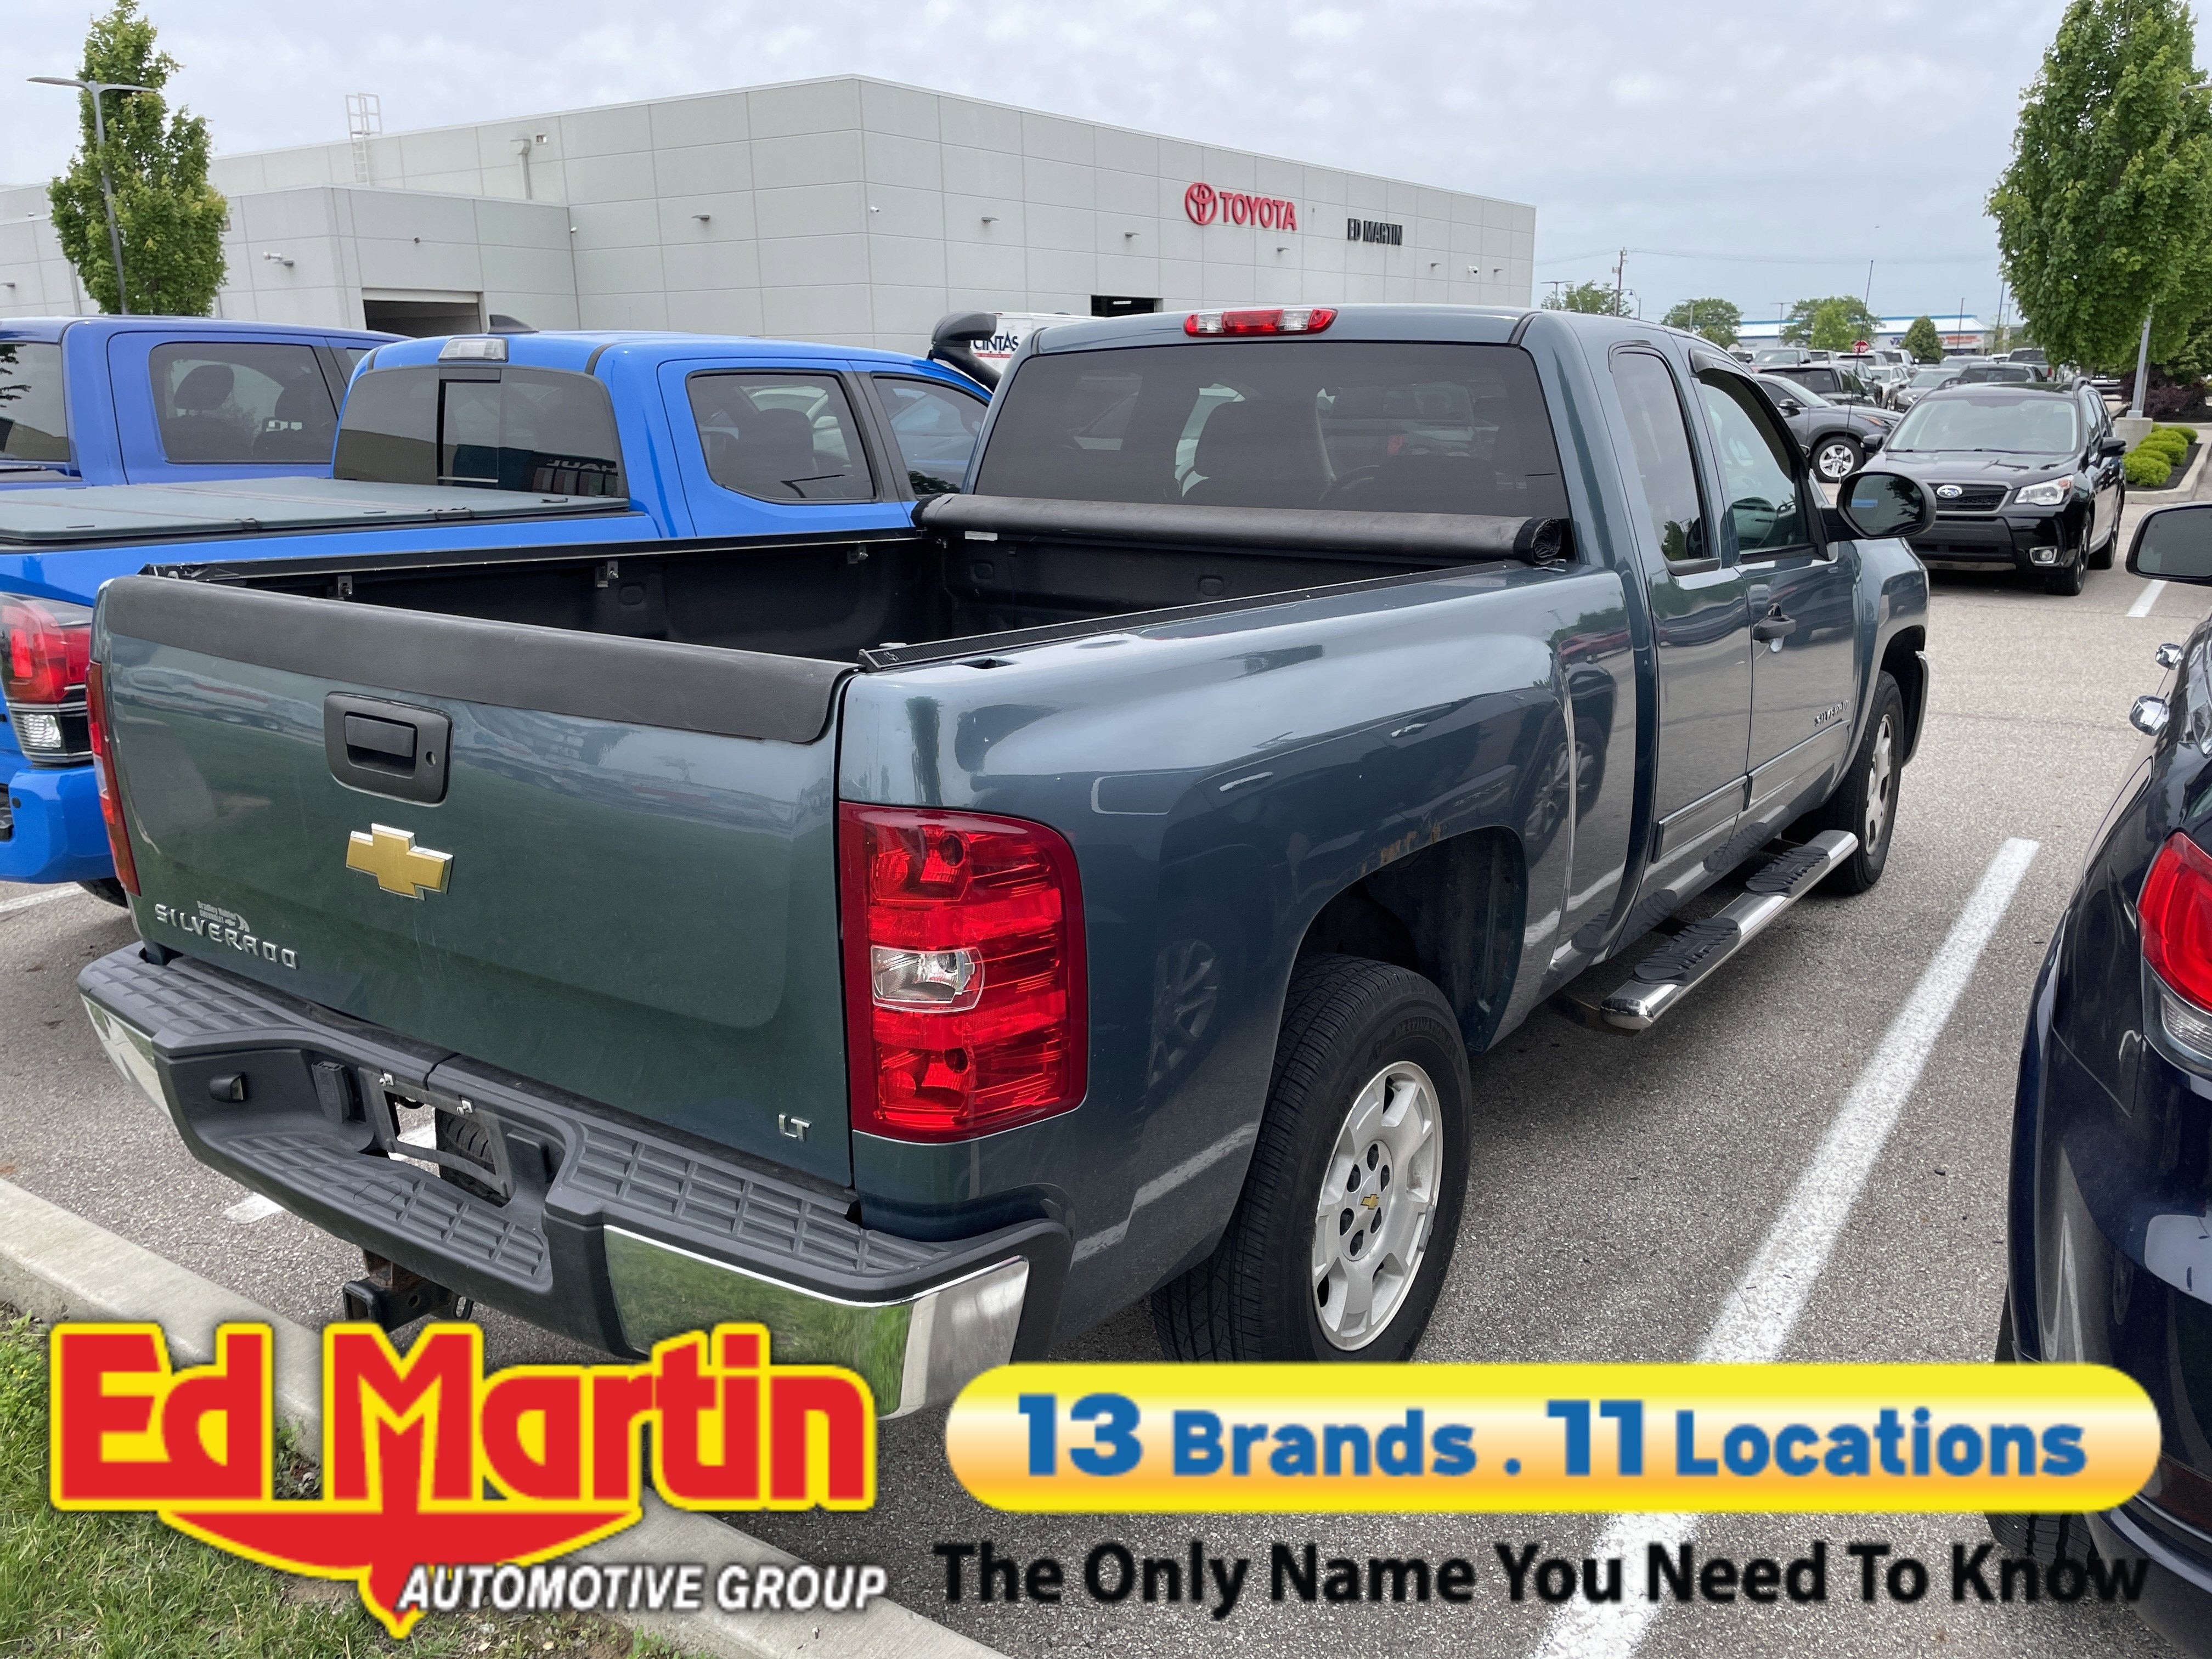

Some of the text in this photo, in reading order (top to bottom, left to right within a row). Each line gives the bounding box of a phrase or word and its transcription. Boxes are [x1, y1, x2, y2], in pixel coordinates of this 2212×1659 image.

[1220, 191, 1297, 231] TOYOTA
[1347, 218, 1403, 245] ED MARTIN
[973, 331, 1019, 352] CINTAS
[154, 903, 300, 970] SILVERADO
[778, 1112, 812, 1142] LT
